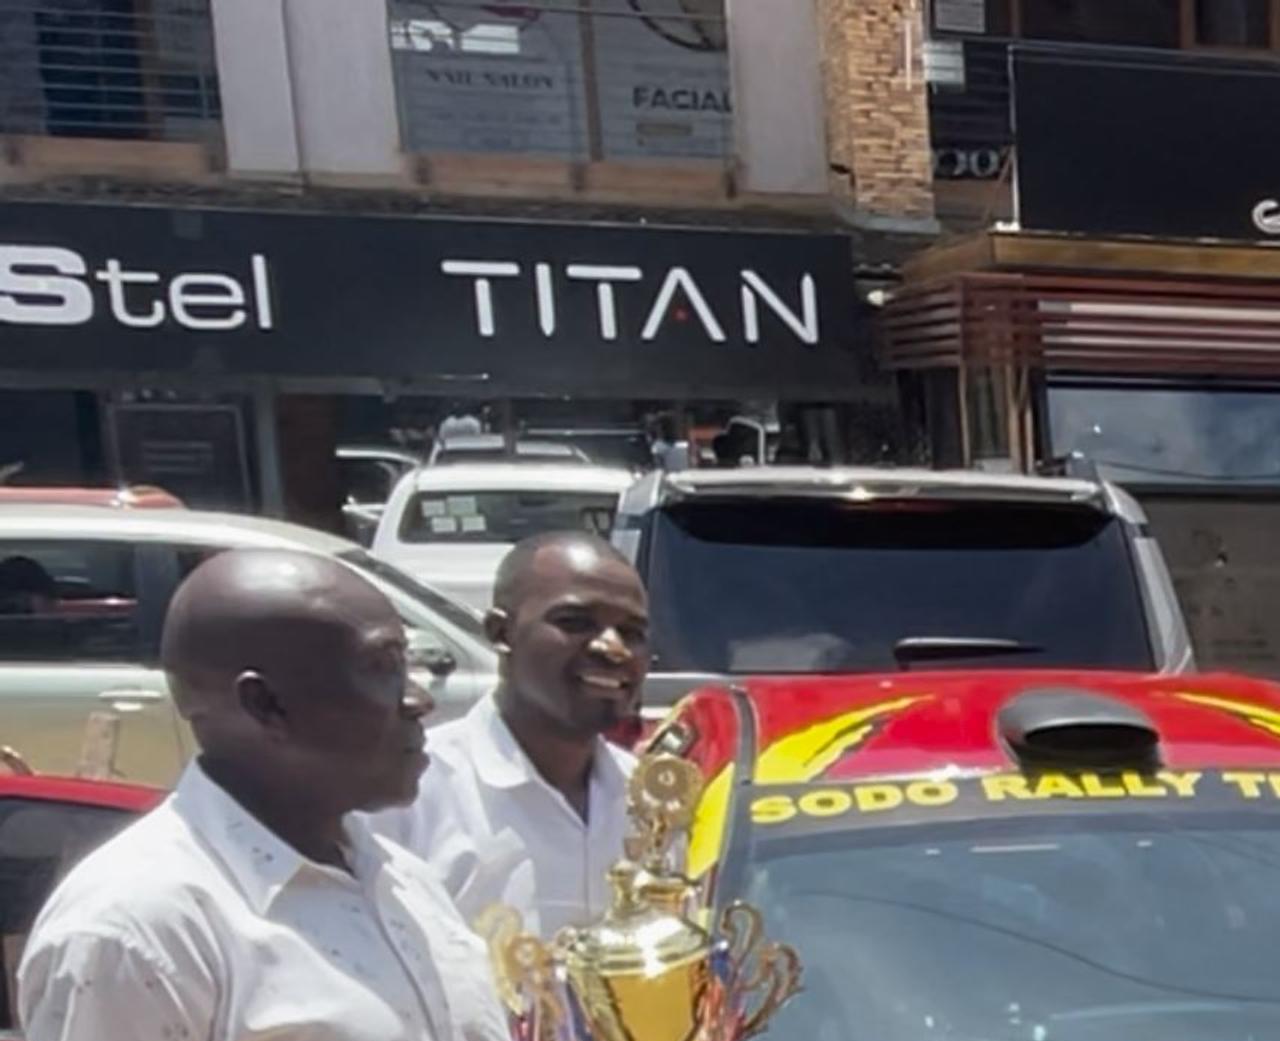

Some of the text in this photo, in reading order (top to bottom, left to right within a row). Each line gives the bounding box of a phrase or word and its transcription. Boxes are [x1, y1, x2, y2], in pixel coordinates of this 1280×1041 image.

[632, 86, 732, 113] FACIAL
[441, 259, 820, 344] TITAN
[750, 780, 959, 824] SODO
[980, 772, 1203, 800] RALLY
